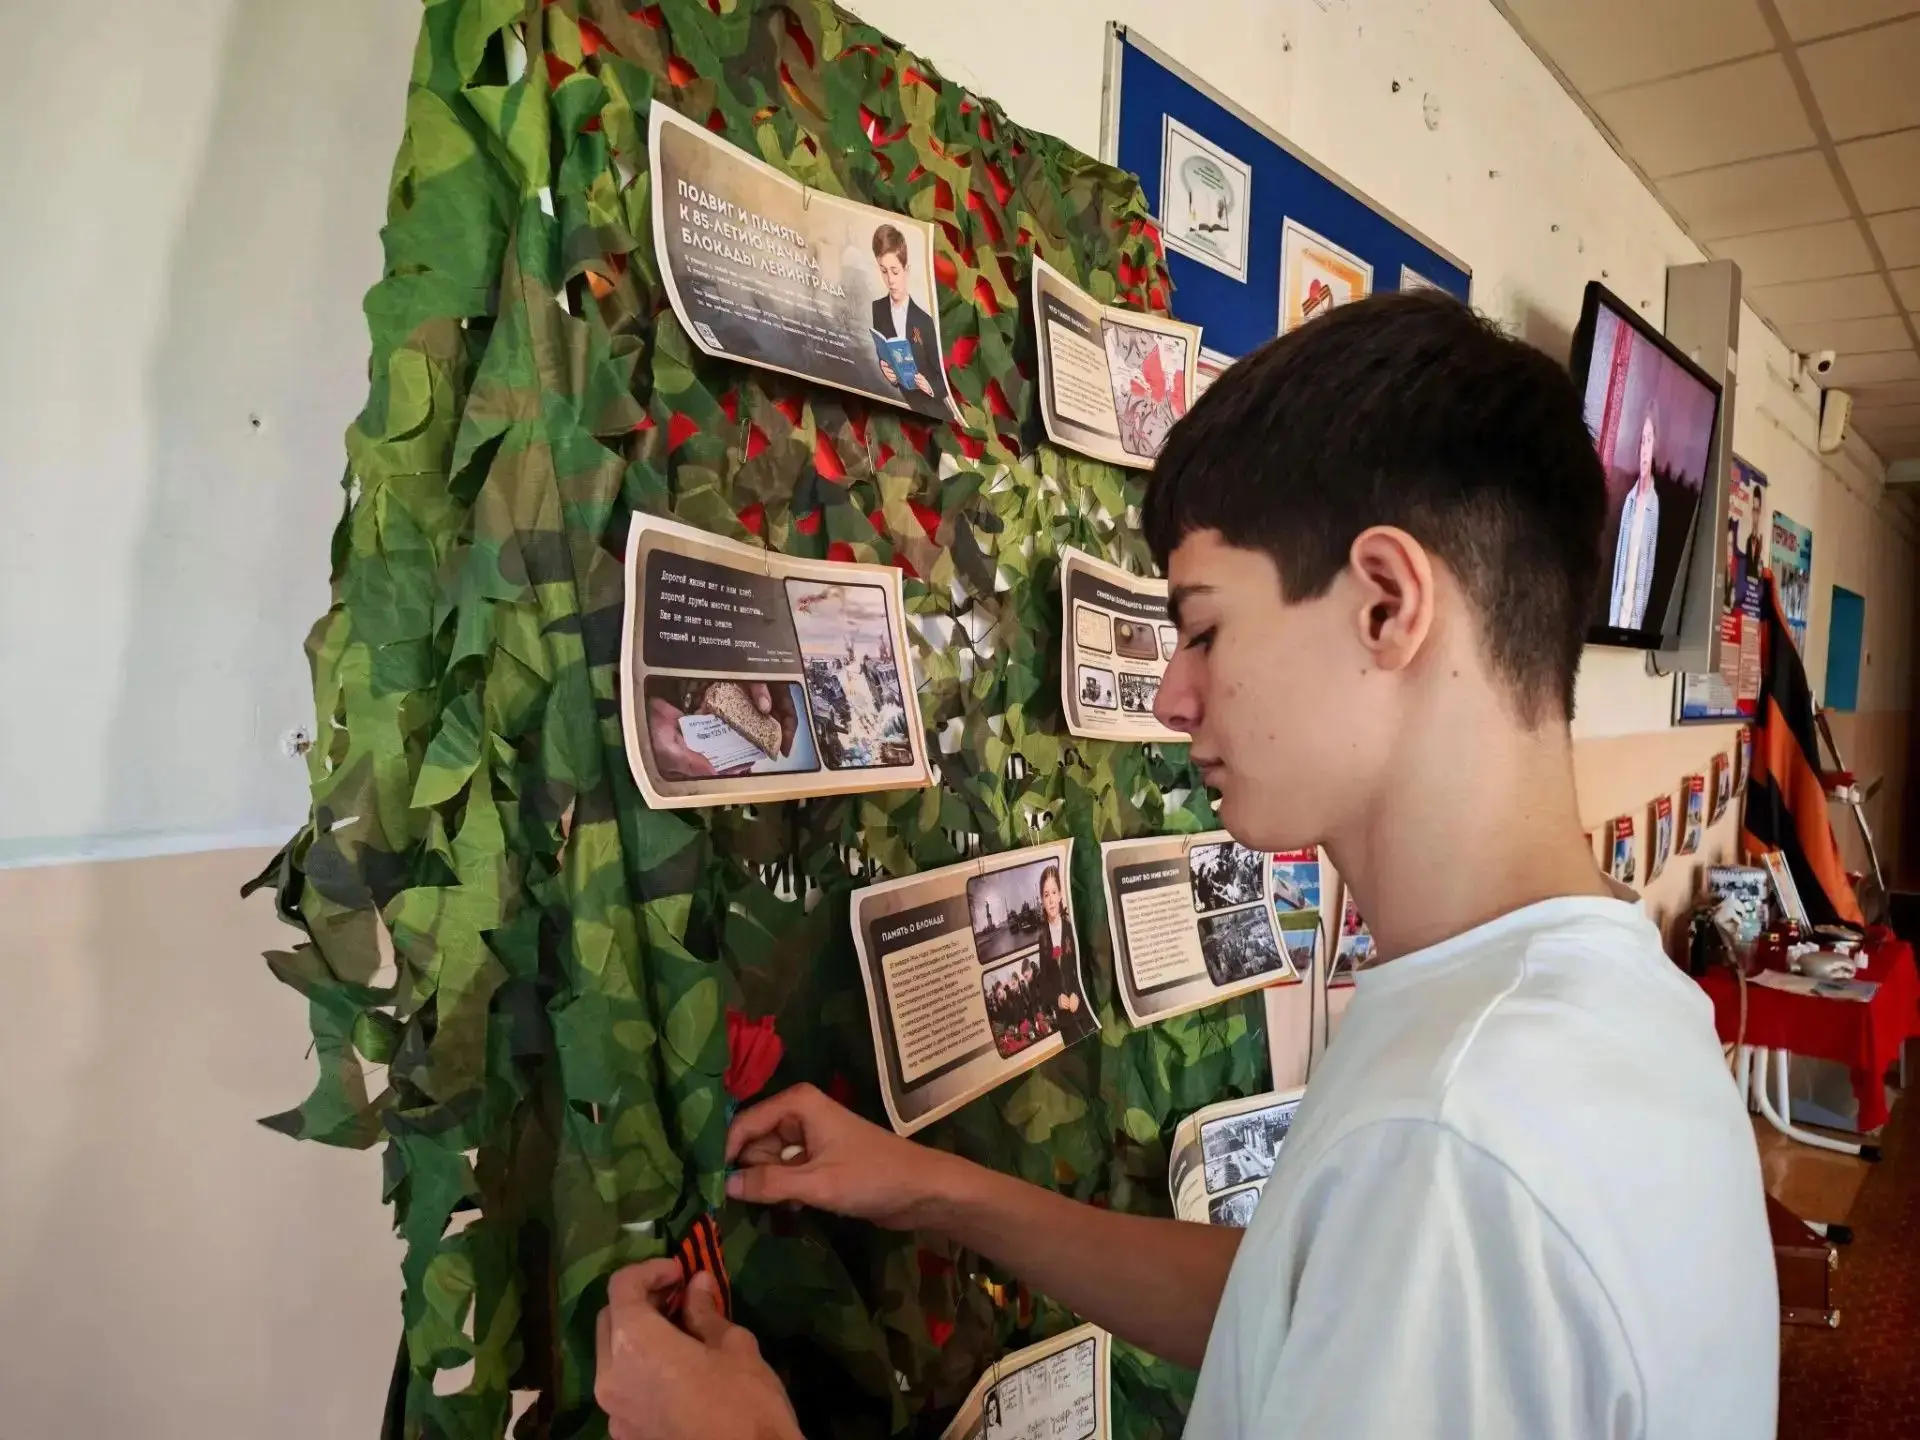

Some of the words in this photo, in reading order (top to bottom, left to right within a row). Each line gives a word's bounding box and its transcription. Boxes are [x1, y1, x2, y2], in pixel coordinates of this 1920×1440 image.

[678, 179, 734, 218] ПОДВИГ
[738, 207, 748, 225] И
[751, 214, 808, 248] ПАМЯТЬ.
[679, 203, 690, 222] К
[692, 209, 763, 250] 85-ЛЕТИЮ
[766, 239, 821, 272] НАЧАЛА
[681, 227, 757, 268] БЛОКАДЫ
[760, 258, 846, 298] ЛЕНИНГРАДА
[661, 569, 687, 584] Дорогой
[660, 591, 685, 605] дорогой
[688, 596, 709, 608] дружбы
[673, 613, 682, 622] не
[704, 618, 712, 627] на
[659, 631, 689, 643] страшней
[691, 635, 696, 643] и
[698, 636, 732, 647] радостней
[881, 926, 909, 942] ПАМЯТЬ
[909, 923, 915, 933] О
[916, 914, 944, 931] БЛОКАДЕ
